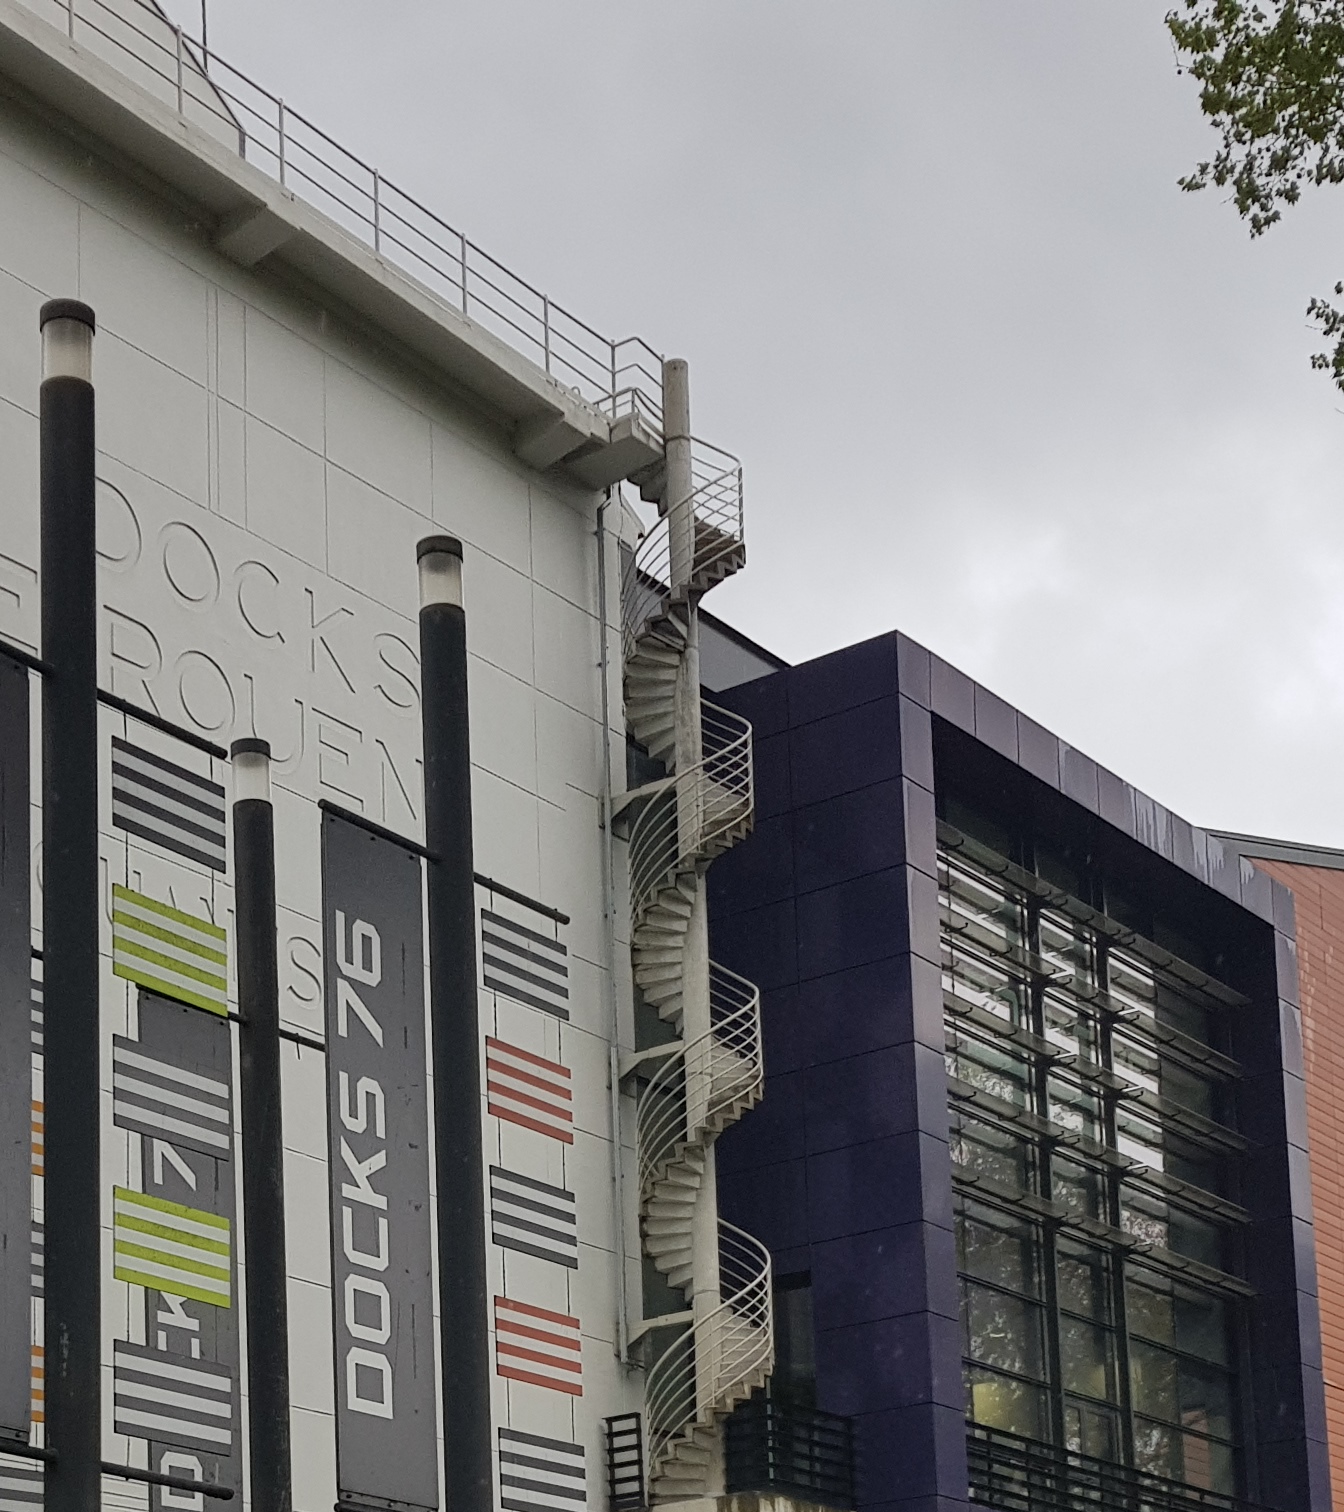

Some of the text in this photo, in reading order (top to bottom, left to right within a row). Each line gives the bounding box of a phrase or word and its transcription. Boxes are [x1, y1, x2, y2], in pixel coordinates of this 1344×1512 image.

[96, 475, 423, 714] DOCKS
[102, 604, 424, 823] ROUEN
[335, 908, 394, 1420] DOCKS 76
